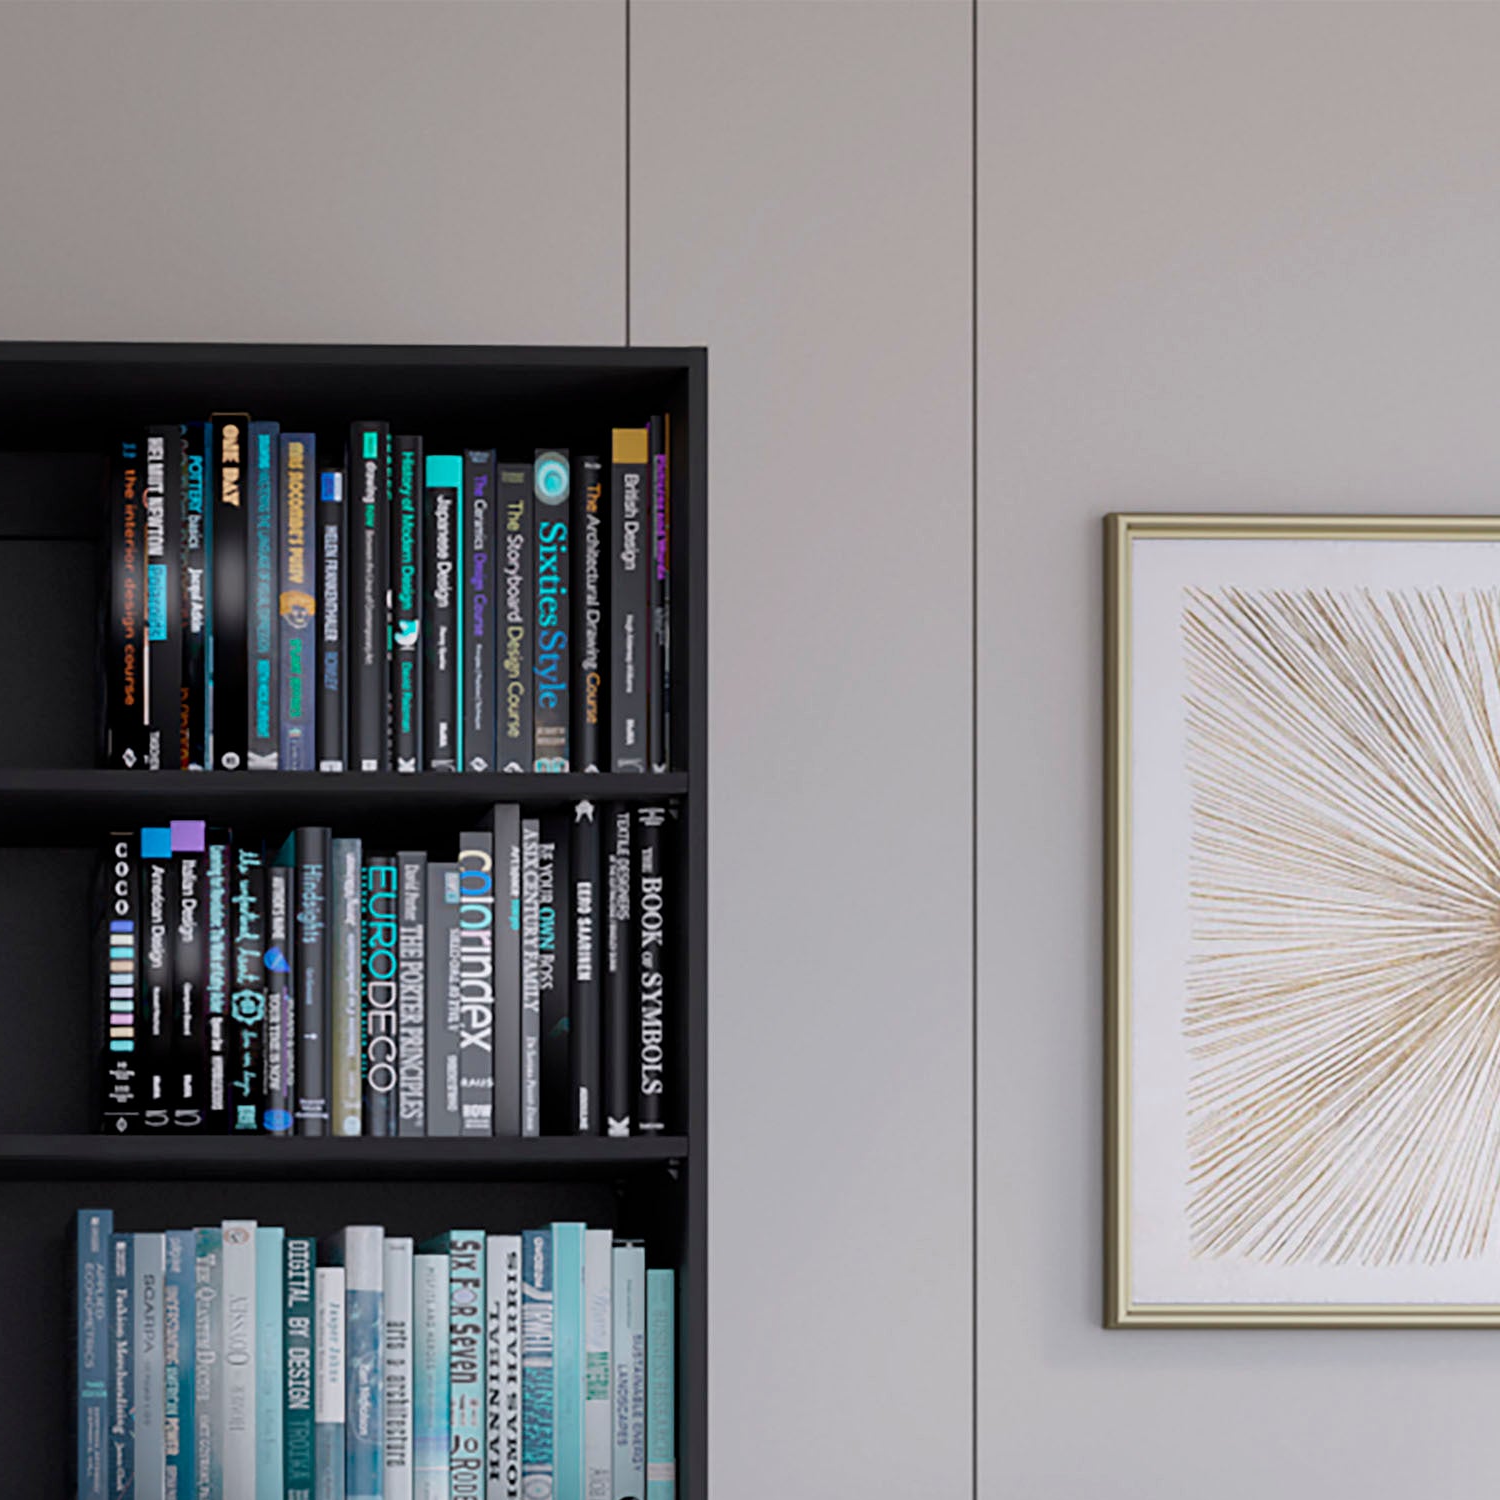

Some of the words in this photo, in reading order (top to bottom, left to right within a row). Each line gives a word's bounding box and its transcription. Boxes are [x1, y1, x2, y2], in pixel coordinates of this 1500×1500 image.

[147, 437, 164, 494] HELMUT
[222, 424, 240, 463] ONE
[123, 469, 137, 499] the
[188, 455, 203, 512] POTTERY
[222, 467, 240, 507] DAY
[399, 451, 414, 497] History
[475, 475, 487, 497] The
[586, 482, 602, 513] The
[624, 473, 640, 518] British
[147, 497, 164, 556] NEWTON
[188, 514, 203, 549] basics
[399, 498, 414, 513] of
[435, 494, 453, 560] Japanese
[475, 498, 487, 551] Ceramics
[507, 500, 523, 531] The
[123, 504, 137, 571] interior
[399, 514, 414, 563] Modern
[586, 514, 602, 606] Architectural
[620, 520, 640, 571] Design
[399, 564, 414, 611] Design
[435, 561, 453, 609] Design
[471, 552, 488, 591] Design
[504, 533, 524, 623] Storyboard
[537, 521, 568, 628] Sixties
[121, 578, 137, 638] design
[475, 593, 487, 637] Course
[504, 625, 524, 679] Design
[581, 609, 601, 670] Drawing
[123, 644, 135, 706] course
[532, 629, 567, 710] Style
[586, 671, 602, 725] Course
[507, 680, 524, 738] Course
[523, 829, 539, 840] A
[523, 843, 539, 865] SIX
[641, 847, 653, 873] THE
[149, 865, 165, 924] American
[179, 859, 197, 897] Italian
[297, 864, 324, 944] Hindsights
[523, 867, 539, 943] CENTURY
[577, 881, 592, 914] EERO
[179, 899, 197, 943] Design
[399, 924, 423, 957] THE
[540, 906, 556, 950] OWN
[640, 876, 663, 948] BOOK
[149, 926, 165, 969] Design
[577, 916, 592, 981] SAARINEN
[368, 866, 397, 1093] EURODECO
[399, 961, 423, 1023] PORTER
[523, 950, 539, 1012] FAMILY
[640, 971, 663, 1095] SYMBOLS
[399, 1026, 423, 1119] PRINCIPLES
[286, 1239, 311, 1307] DIGITAL
[116, 1288, 128, 1335] Fashion
[142, 1273, 155, 1353] SCARPA
[286, 1316, 311, 1340] BY
[386, 1320, 408, 1348] arts
[506, 1251, 518, 1383] HARRIS
[113, 1339, 128, 1436] Merchandising
[286, 1347, 311, 1411] DESIGN
[489, 1301, 500, 1481] HANNIBAL
[631, 1333, 643, 1415] SUSTAINABLE
[386, 1375, 408, 1468] architecture
[616, 1363, 629, 1446] LANDSCAPES
[286, 1420, 311, 1480] TROIKA
[631, 1421, 643, 1472] ENERGY
